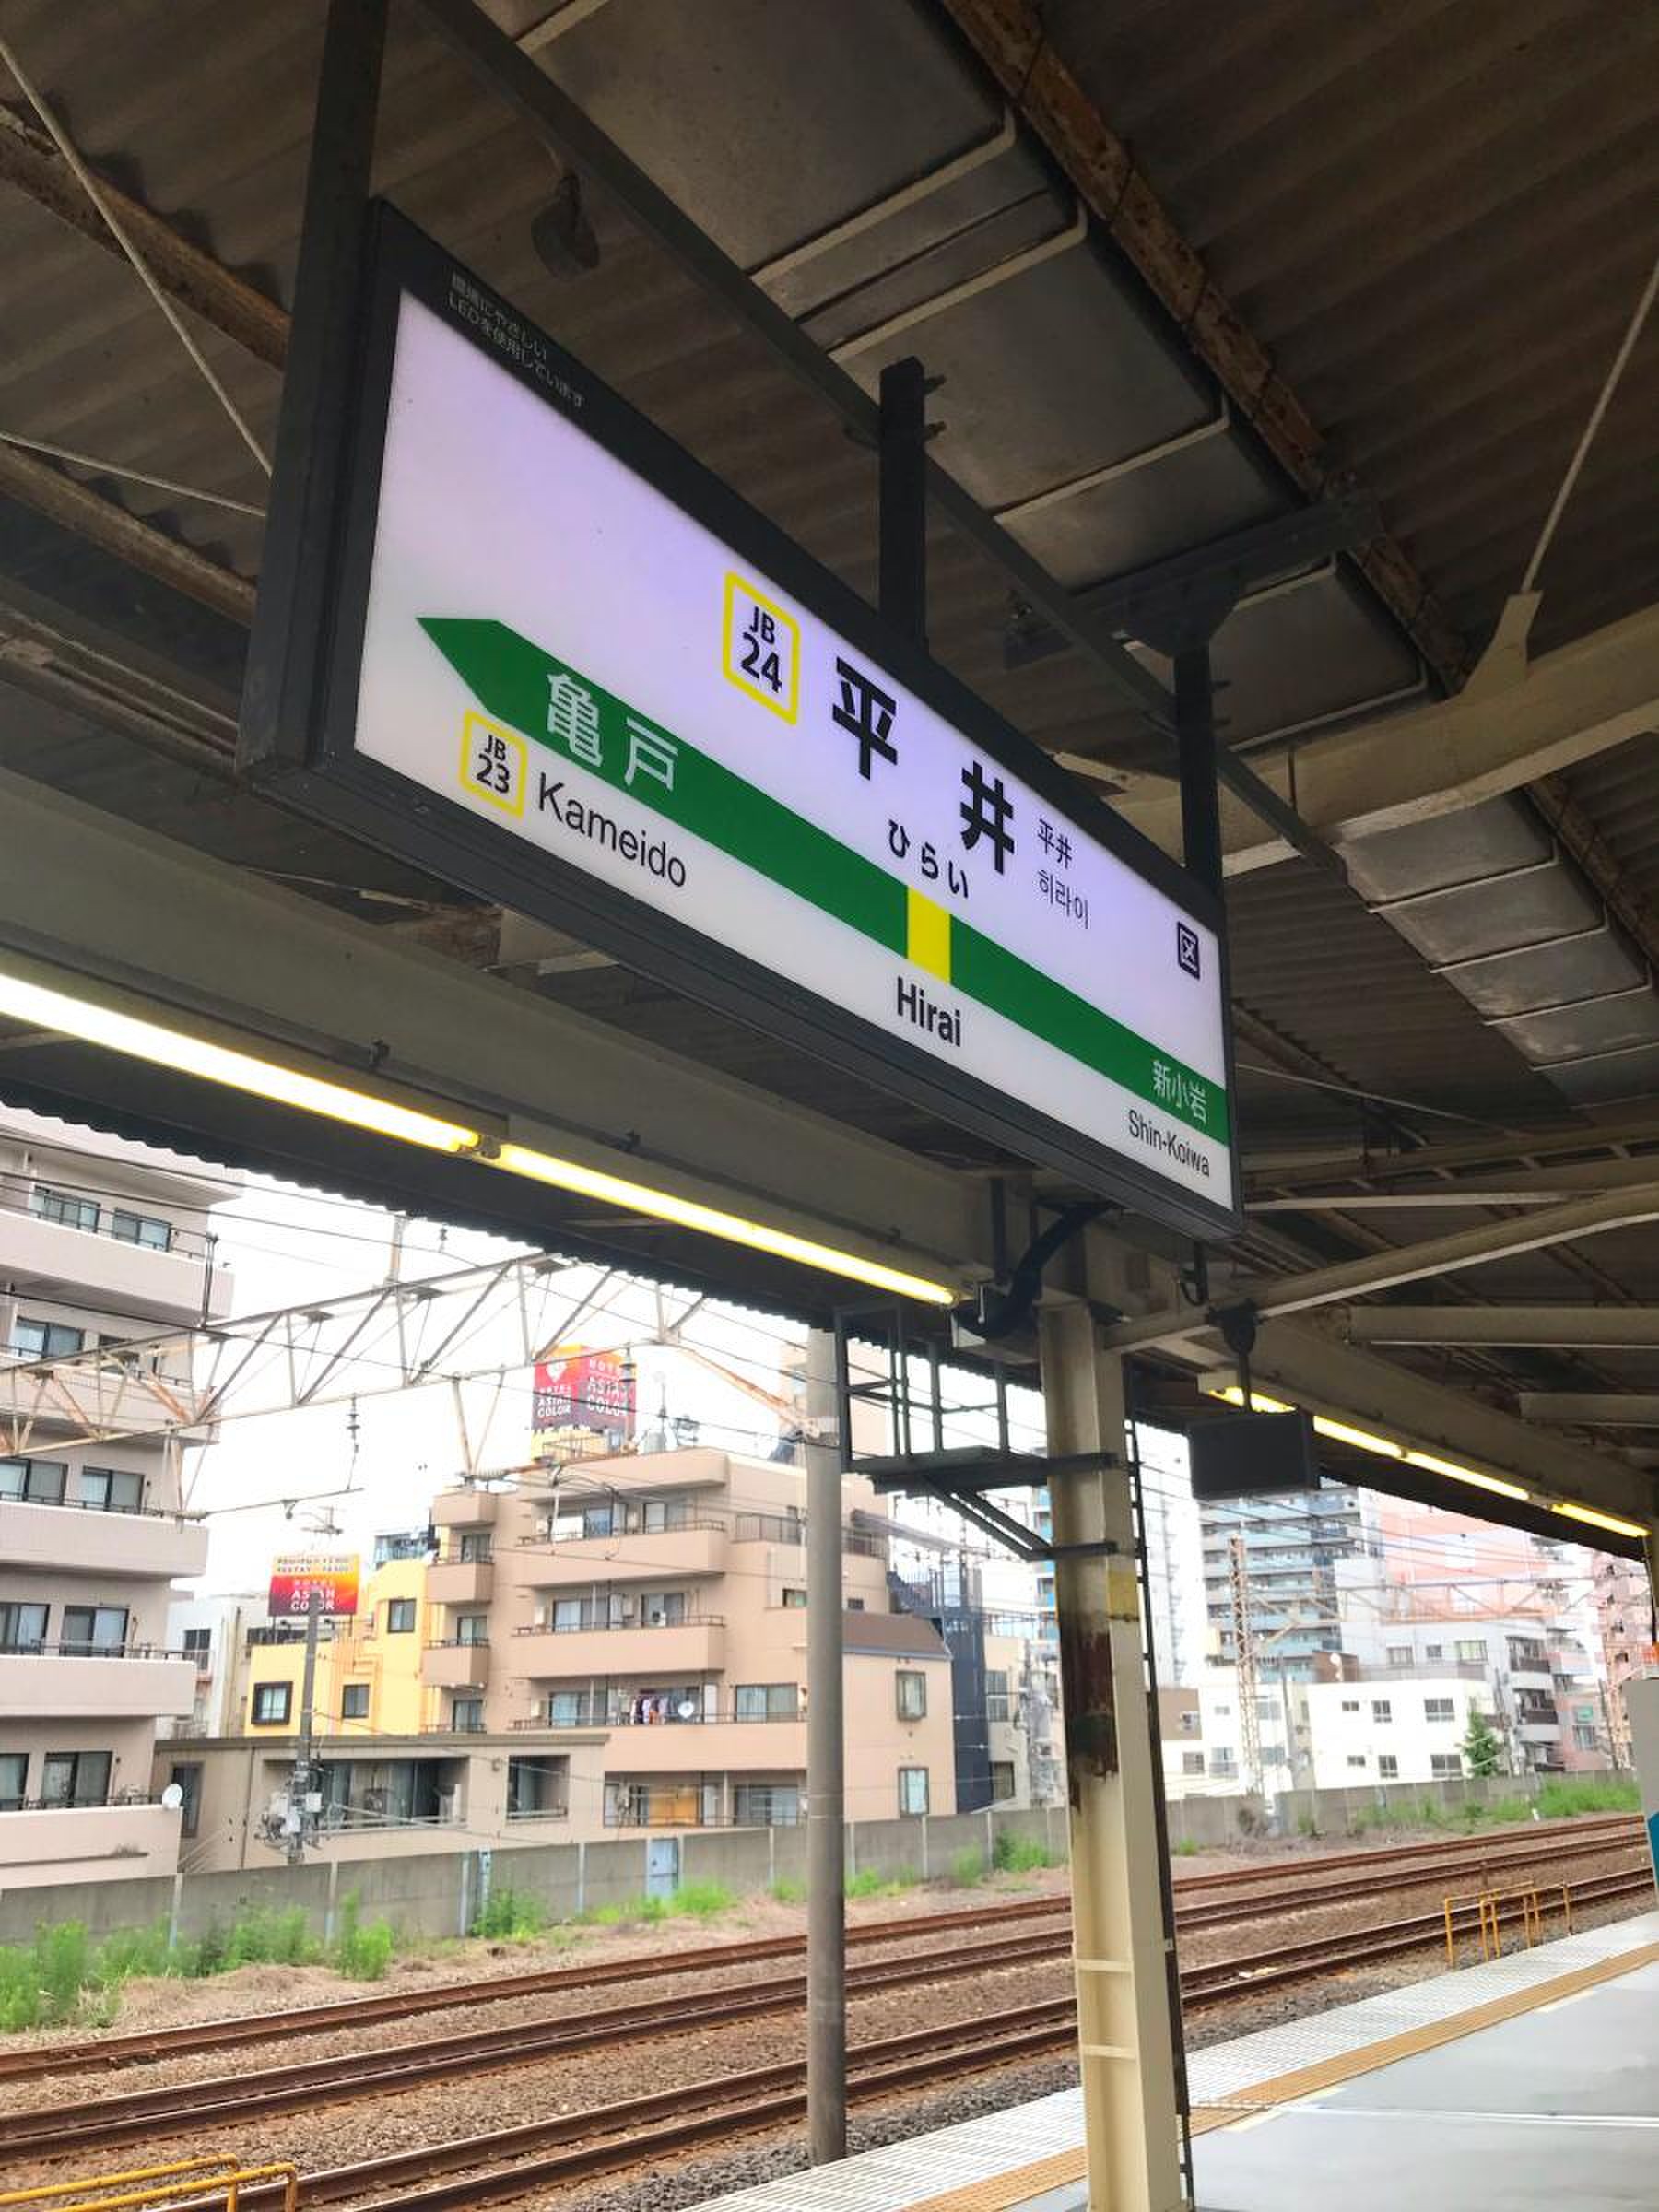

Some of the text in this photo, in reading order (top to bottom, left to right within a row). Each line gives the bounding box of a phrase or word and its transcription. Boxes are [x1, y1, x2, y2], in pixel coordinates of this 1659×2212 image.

[749, 607, 776, 645] JB
[741, 632, 782, 693] 24
[483, 735, 506, 762] JB
[548, 674, 677, 791] 亀戸
[476, 757, 511, 794] 23
[832, 657, 1015, 874] 平井
[538, 772, 687, 888] Kameido
[888, 820, 970, 899] ひらい
[1037, 819, 1073, 869] 平井
[1037, 870, 1089, 930] 히라이
[896, 977, 961, 1048] Hirai
[1152, 1059, 1208, 1125] 新小岩
[1128, 1110, 1211, 1179] Shin-Koiwa
[536, 1405, 571, 1418] COLOR
[291, 1589, 335, 1600] ASAN
[291, 1600, 335, 1611] COOR
